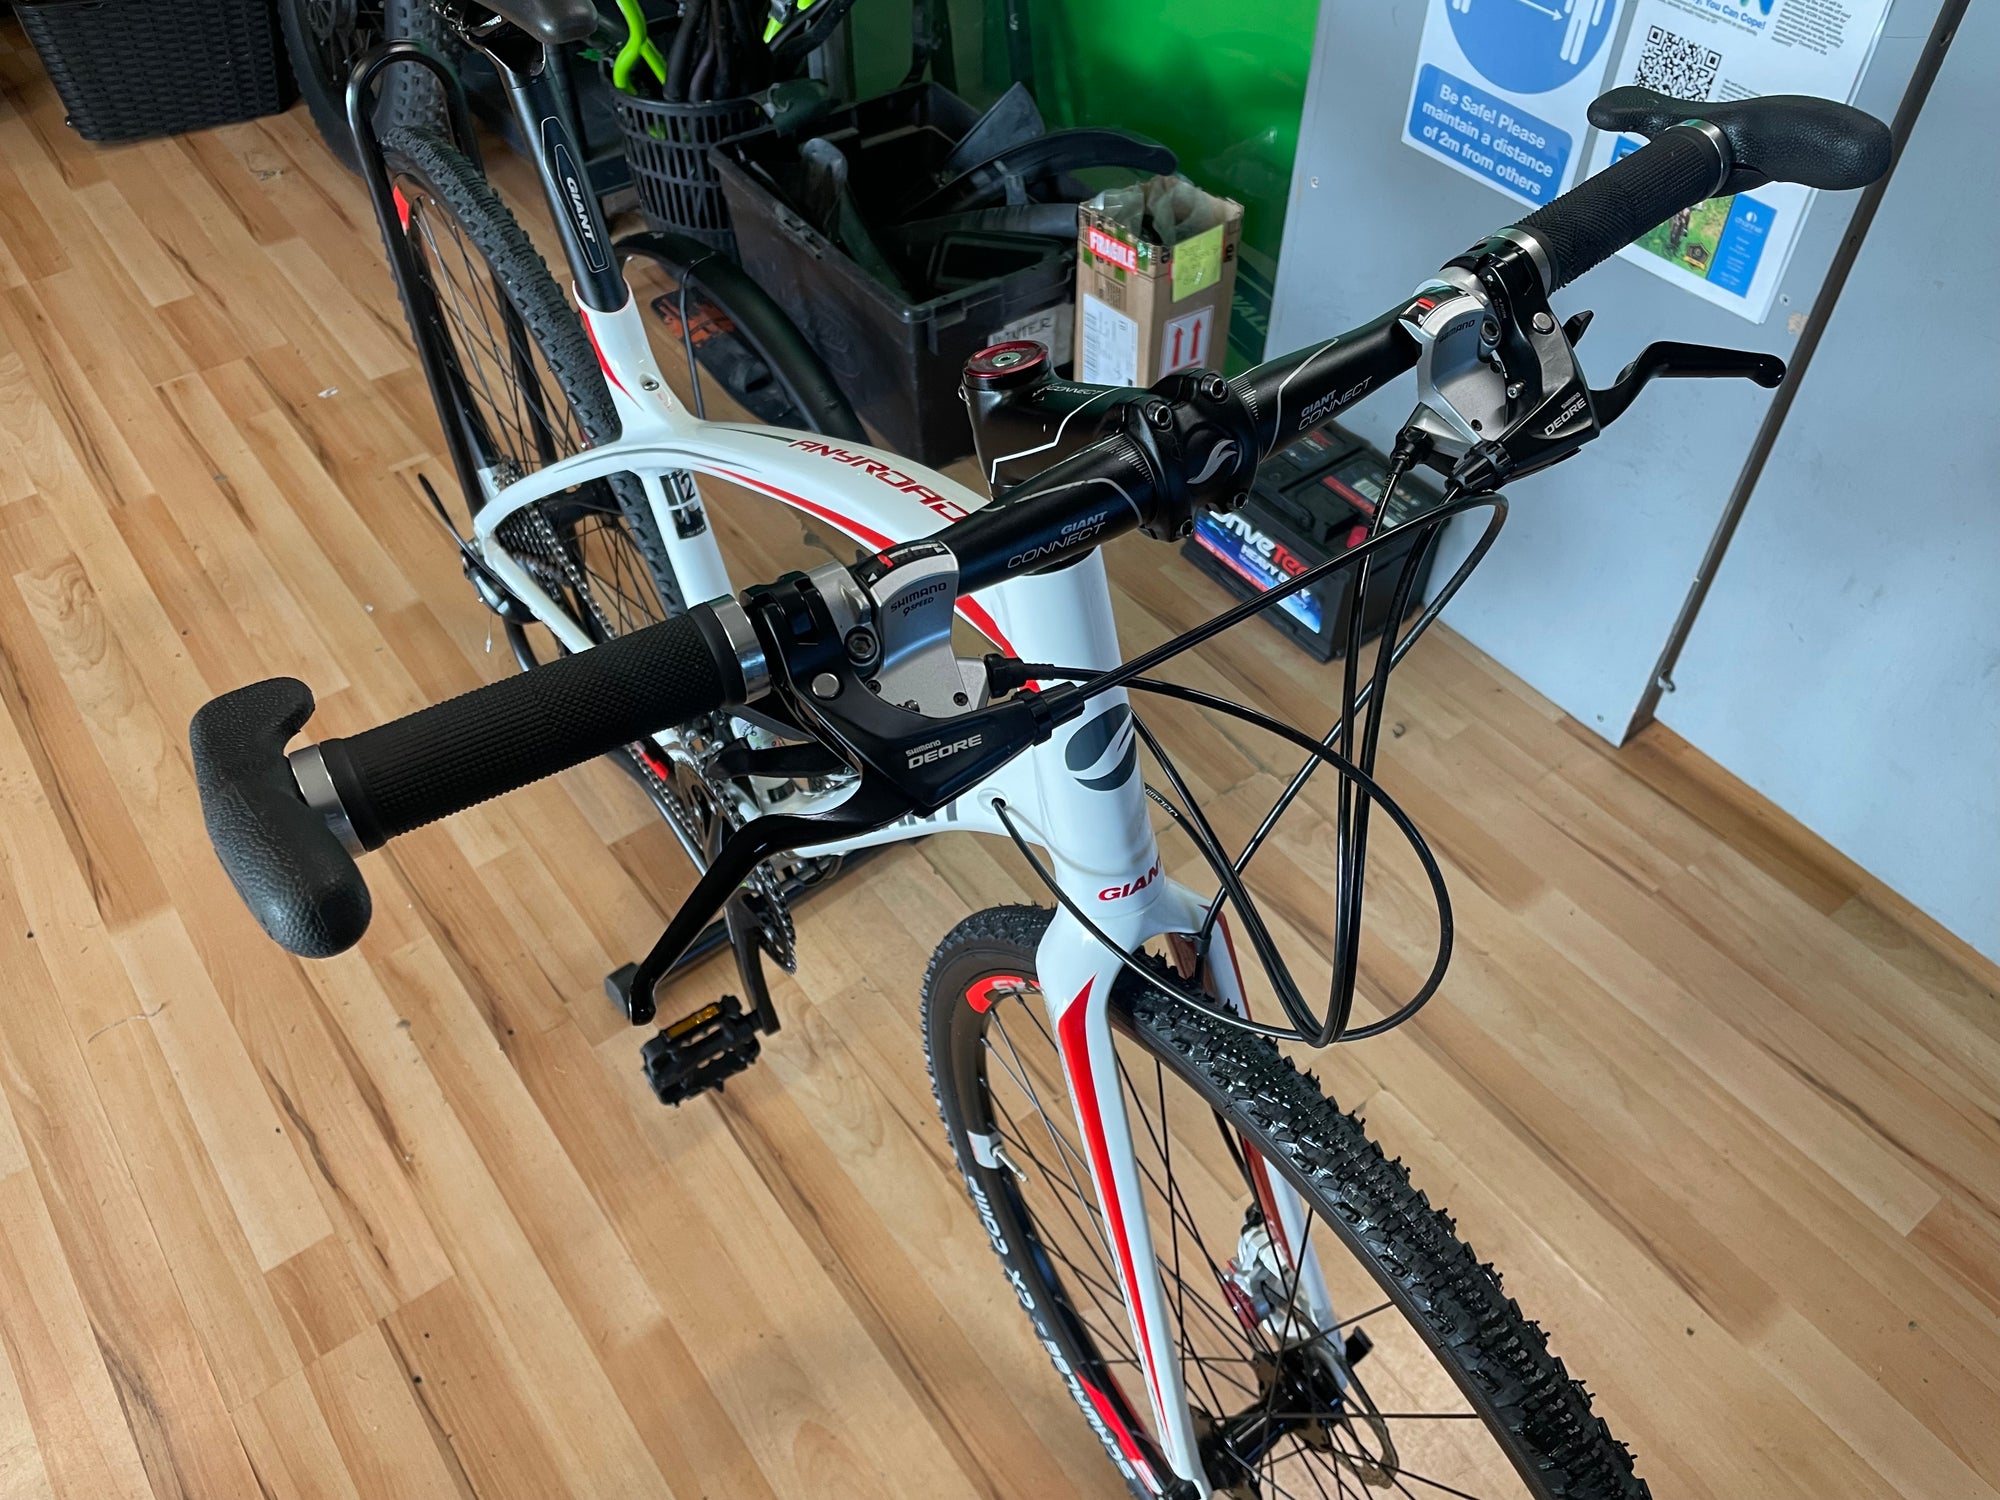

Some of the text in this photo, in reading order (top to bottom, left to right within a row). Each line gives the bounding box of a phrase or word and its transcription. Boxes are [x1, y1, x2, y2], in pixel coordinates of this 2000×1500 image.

[1422, 101, 1553, 177] maintain a distance
[1440, 83, 1546, 149] Be Safe! Please
[1423, 125, 1541, 196] of 2m from others
[566, 176, 597, 243] GIANT
[1089, 230, 1137, 272] FRAGILE
[1298, 375, 1373, 431] CONNECT
[1301, 389, 1337, 418] GIANT
[1544, 397, 1587, 437] DEORE
[788, 440, 970, 523] ANYROAD
[1007, 521, 1106, 569] CONNECT
[1061, 511, 1108, 535] GIANT
[890, 582, 947, 613] SHIMANO
[905, 739, 942, 757] SHIMANO
[908, 734, 982, 770] DEORE
[1098, 854, 1162, 902] GIAN
[967, 1175, 1010, 1256] COMP
